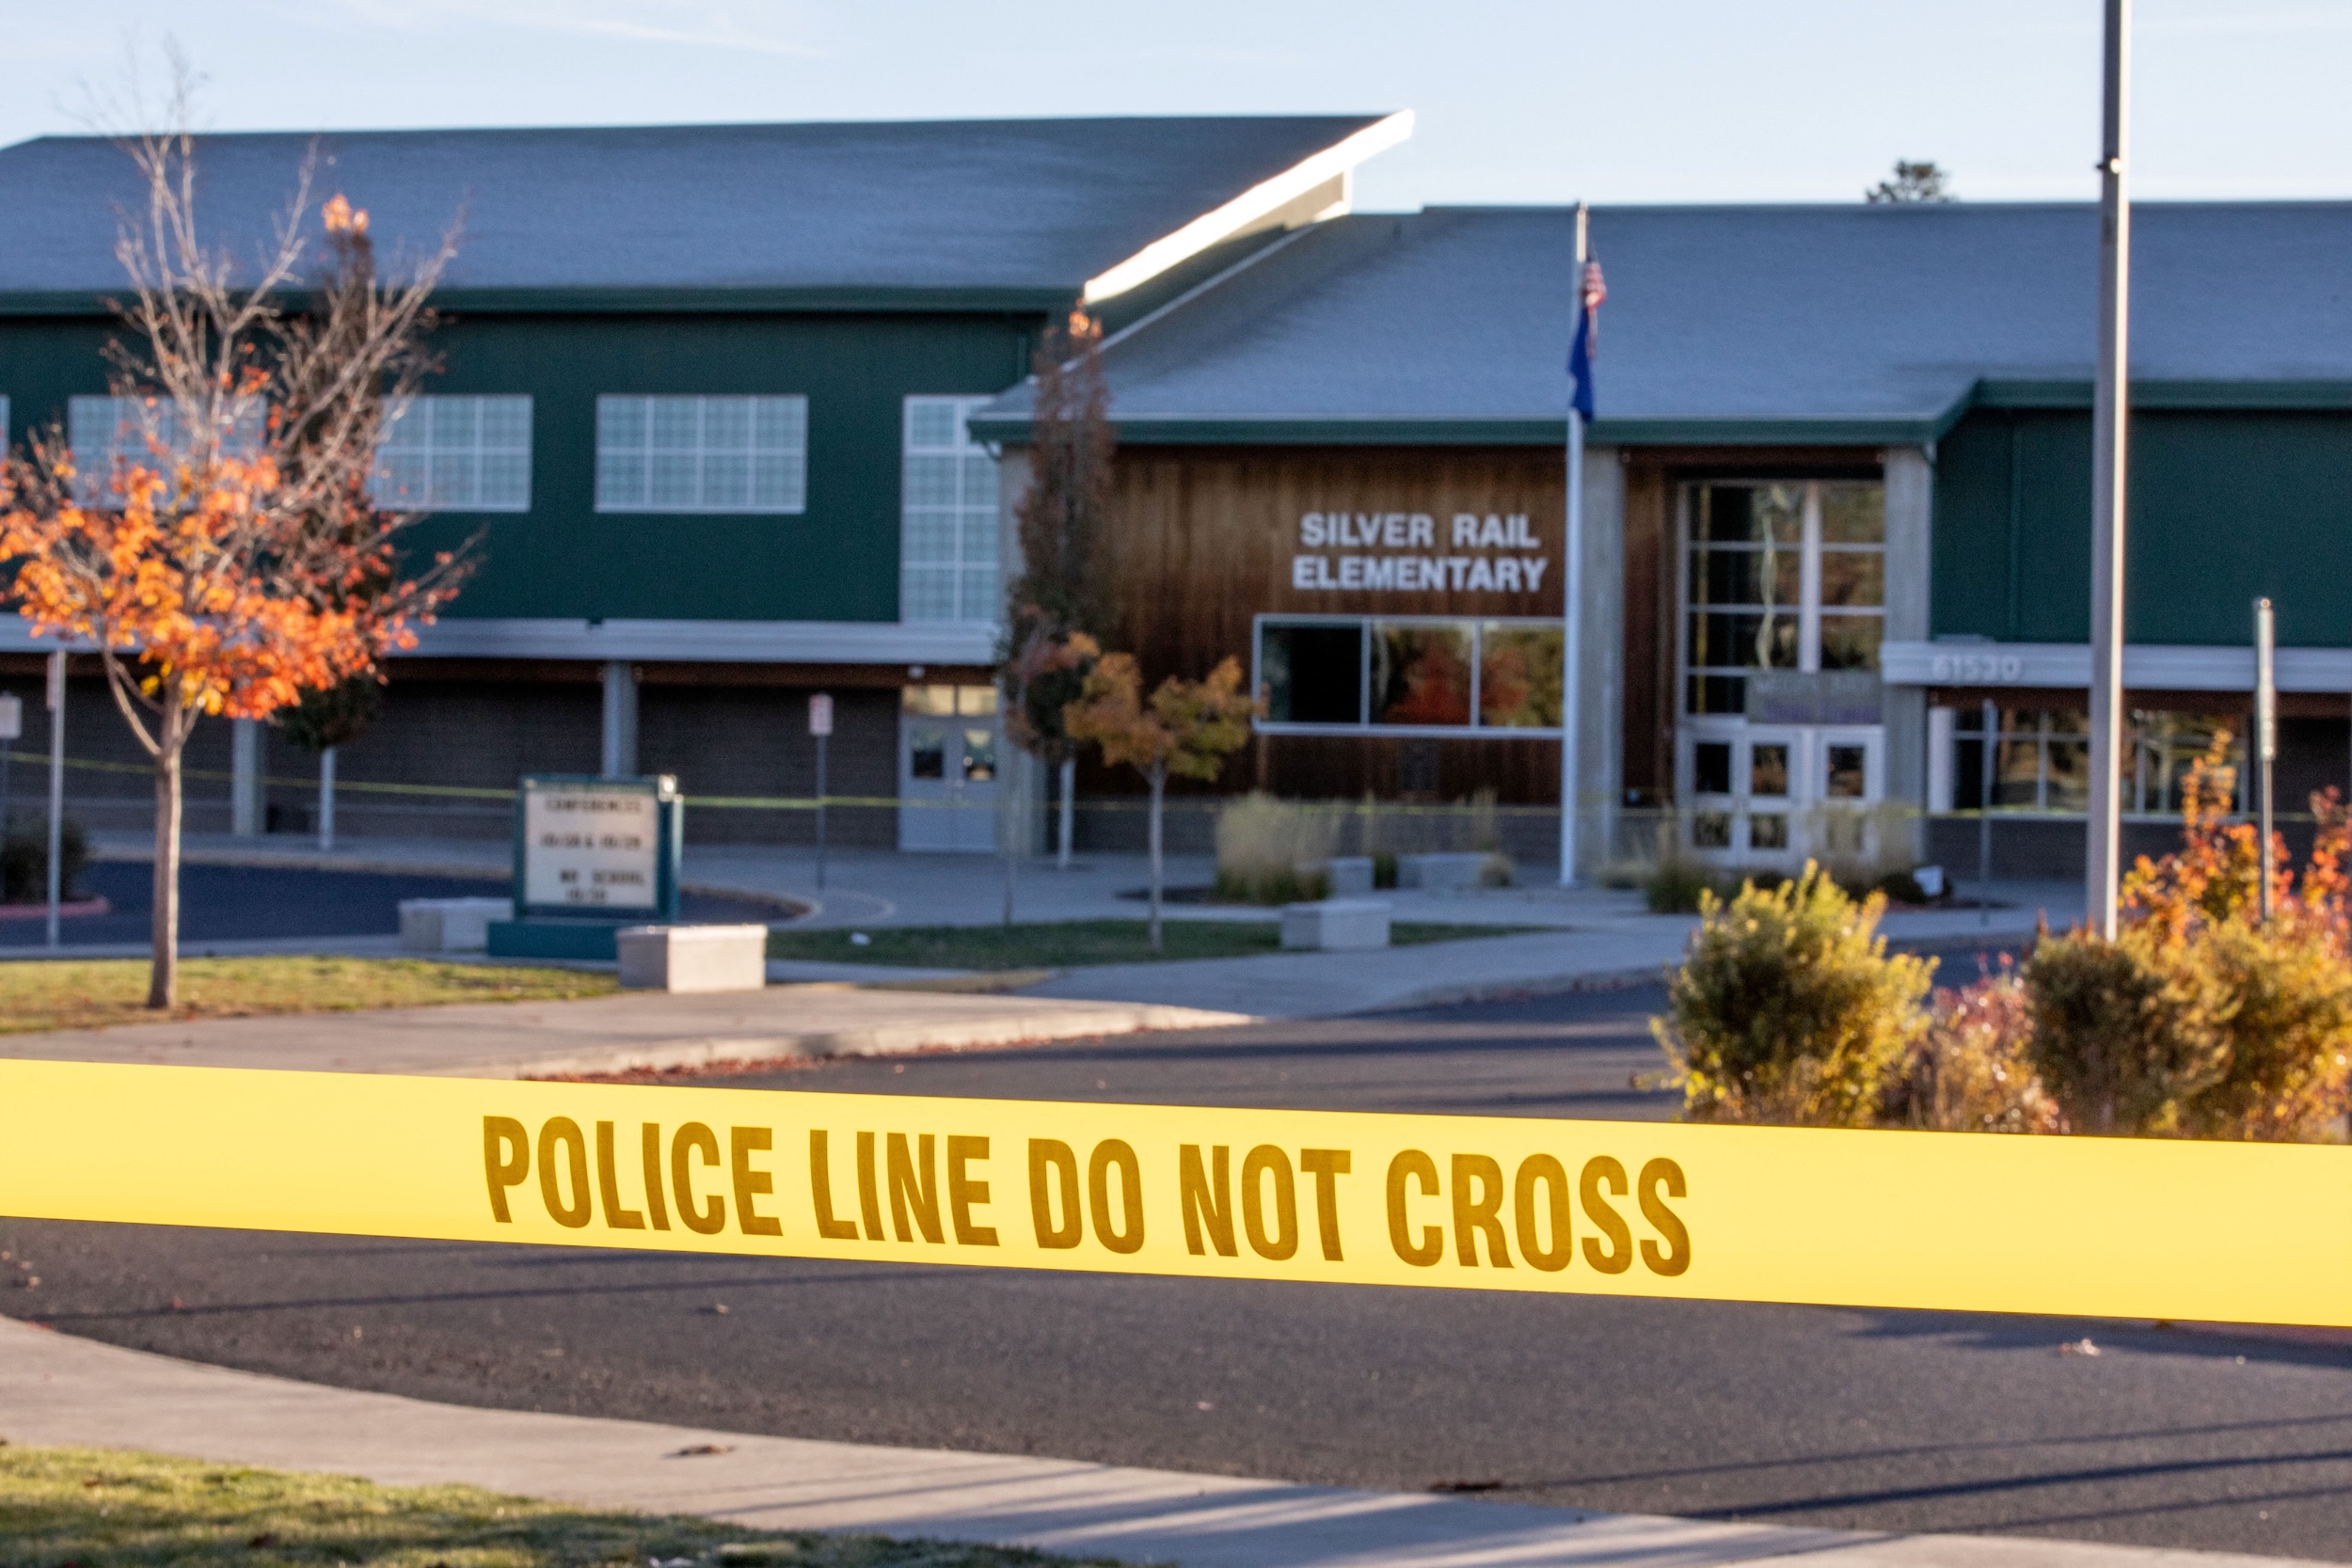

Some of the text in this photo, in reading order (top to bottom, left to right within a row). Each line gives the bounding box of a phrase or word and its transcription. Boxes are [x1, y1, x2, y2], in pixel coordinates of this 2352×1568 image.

[1300, 512, 1541, 548] SILVER RAIL
[1292, 555, 1549, 593] ELEMENTARY
[484, 1115, 1692, 1278] POLICE LINE DO NOT CROSS
